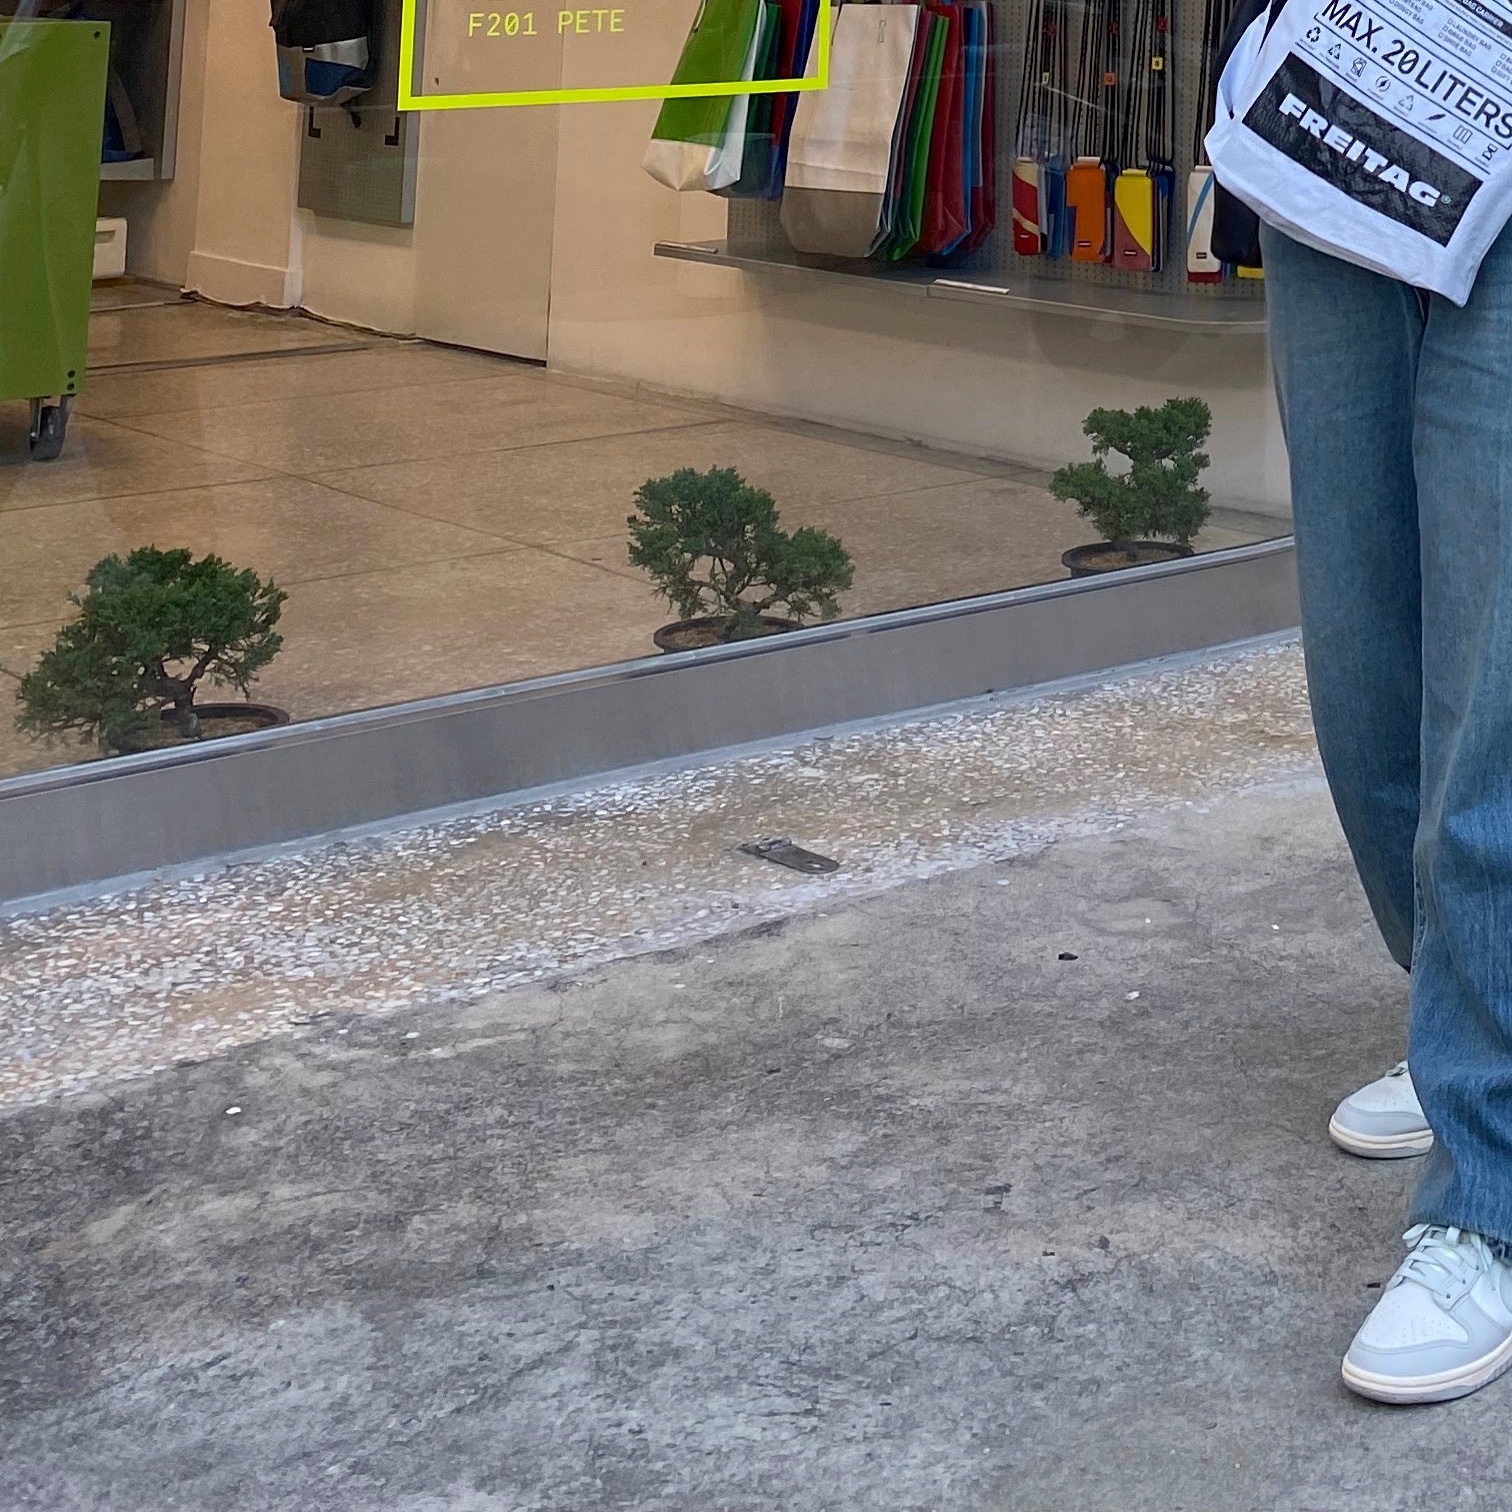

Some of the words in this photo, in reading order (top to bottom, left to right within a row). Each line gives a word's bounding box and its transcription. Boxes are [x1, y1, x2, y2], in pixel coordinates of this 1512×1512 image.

[468, 12, 537, 36] F201
[557, 9, 624, 34] PETE
[1382, 40, 1419, 76] 20
[1278, 93, 1442, 208] FREITAG
